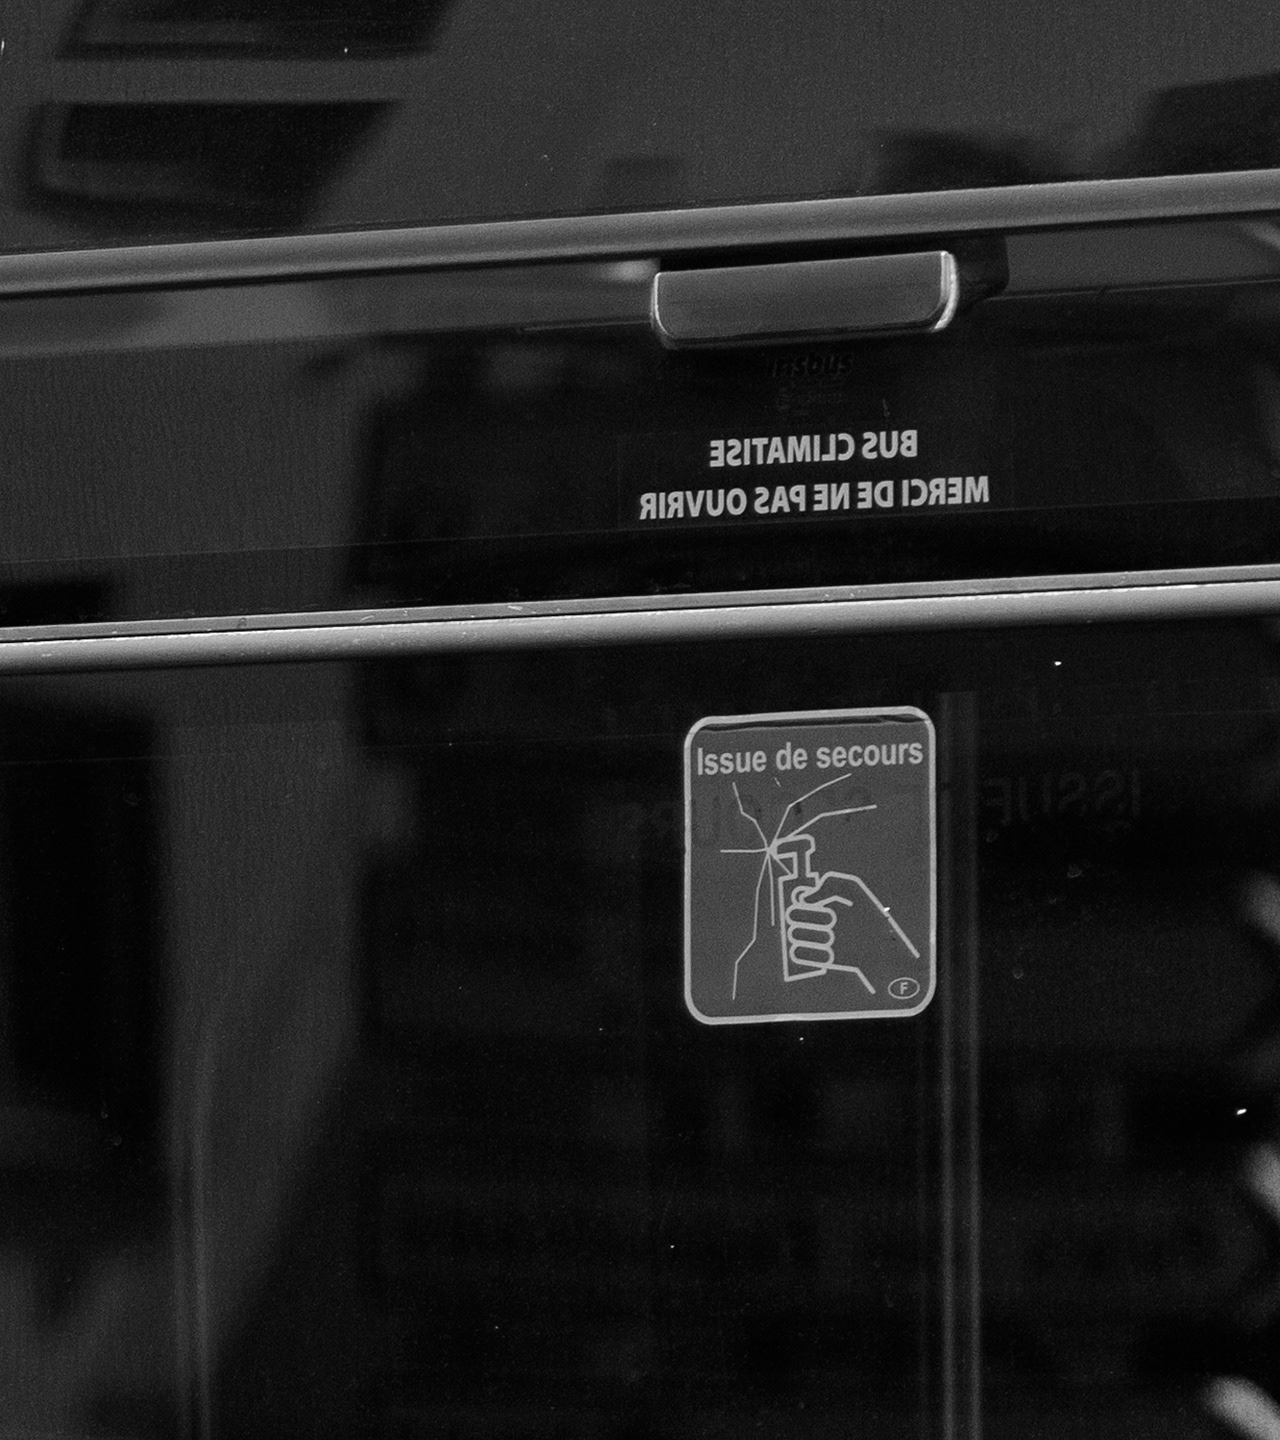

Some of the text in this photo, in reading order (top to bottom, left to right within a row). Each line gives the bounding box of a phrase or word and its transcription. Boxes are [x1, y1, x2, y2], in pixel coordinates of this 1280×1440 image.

[697, 741, 924, 776] Issue de secours
[899, 982, 909, 995] F
